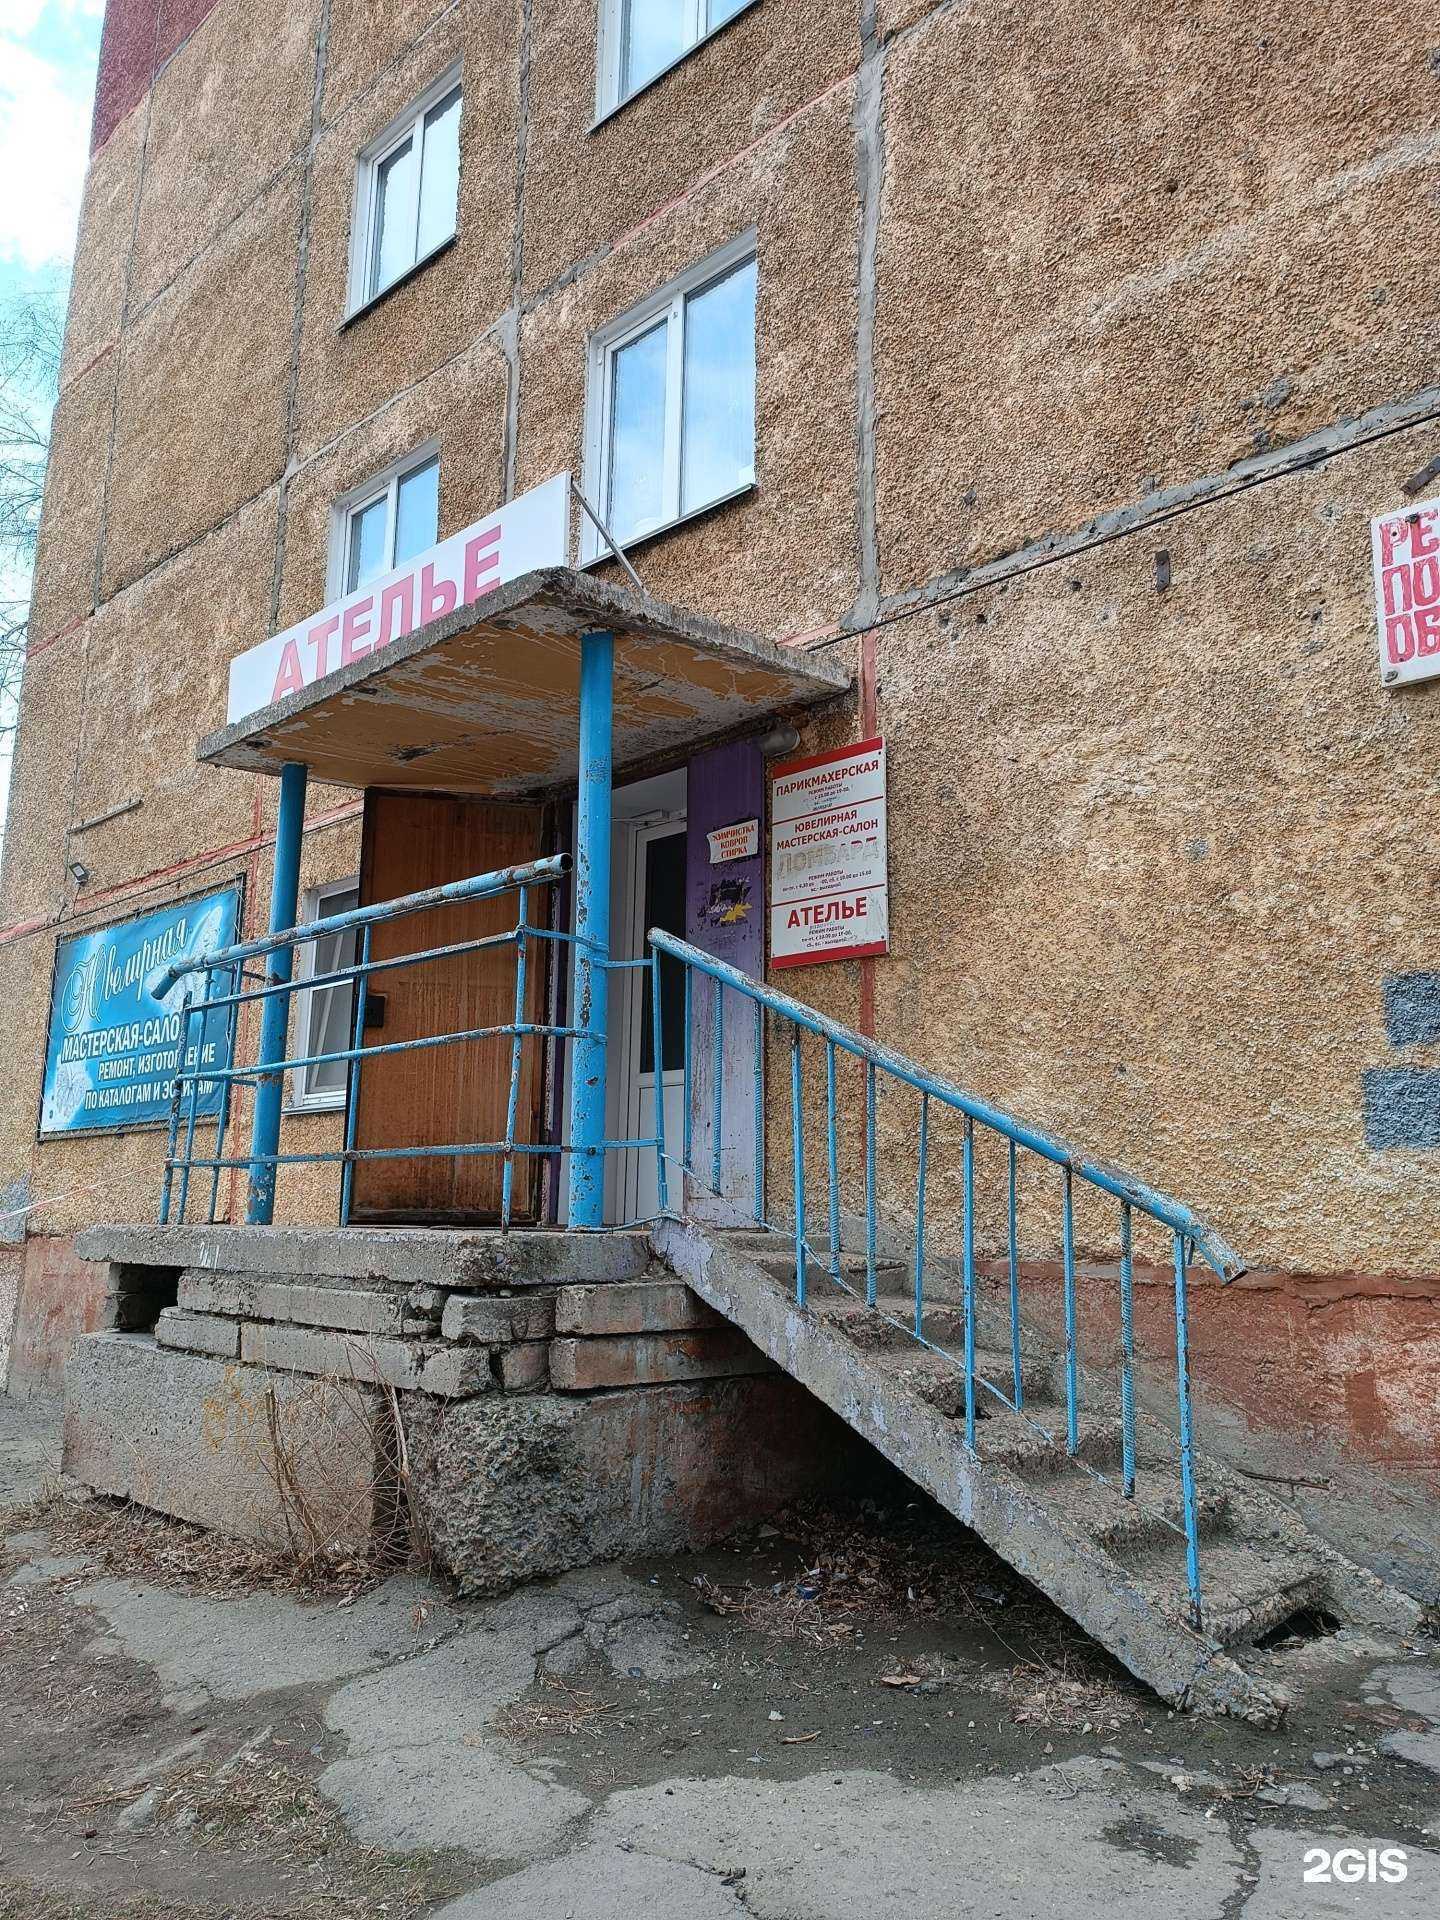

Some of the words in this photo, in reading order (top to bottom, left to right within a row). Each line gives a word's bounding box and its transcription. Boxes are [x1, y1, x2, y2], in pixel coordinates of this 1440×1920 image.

[270, 524, 502, 702] АТЕЛЬЕ
[776, 760, 879, 797] ПАРИКМАХЕРСКАЯ
[712, 824, 755, 841] ХИМЧИСТКА
[777, 819, 878, 850] МАСТЕРСКАЯ-САЛОН
[795, 810, 857, 833] ЮВЕЛИРНАЯ
[720, 836, 748, 849] КОВРОВ
[721, 847, 748, 858] СТИРКА
[787, 896, 867, 929] АТЕЛЬЕ
[61, 1013, 183, 1062] МАСТЕРСКАЯ-САЛО
[98, 1057, 136, 1081] РЕМОНТ,
[138, 1043, 217, 1074] ИЗГОТОЕНИЕ
[84, 1090, 97, 1110] ПО
[98, 1082, 151, 1109] КАТАЛОГАМ
[153, 1081, 161, 1100] И
